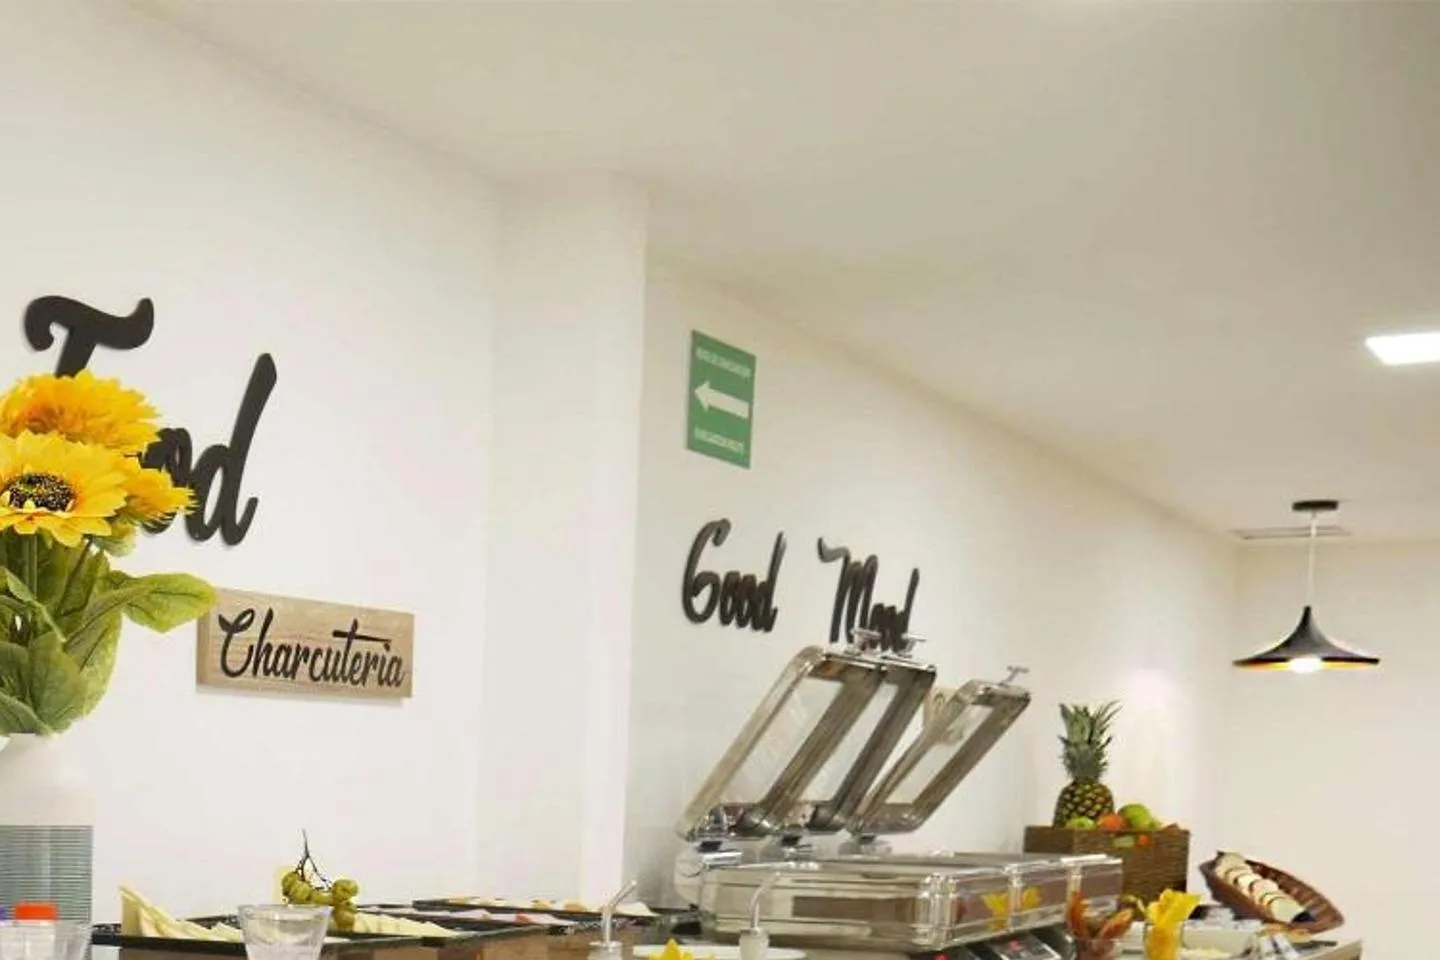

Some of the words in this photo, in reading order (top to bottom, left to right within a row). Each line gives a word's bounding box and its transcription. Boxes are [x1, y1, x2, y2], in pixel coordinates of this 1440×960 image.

[24, 295, 277, 545] od
[682, 518, 787, 632] Good
[817, 537, 920, 654] Mood
